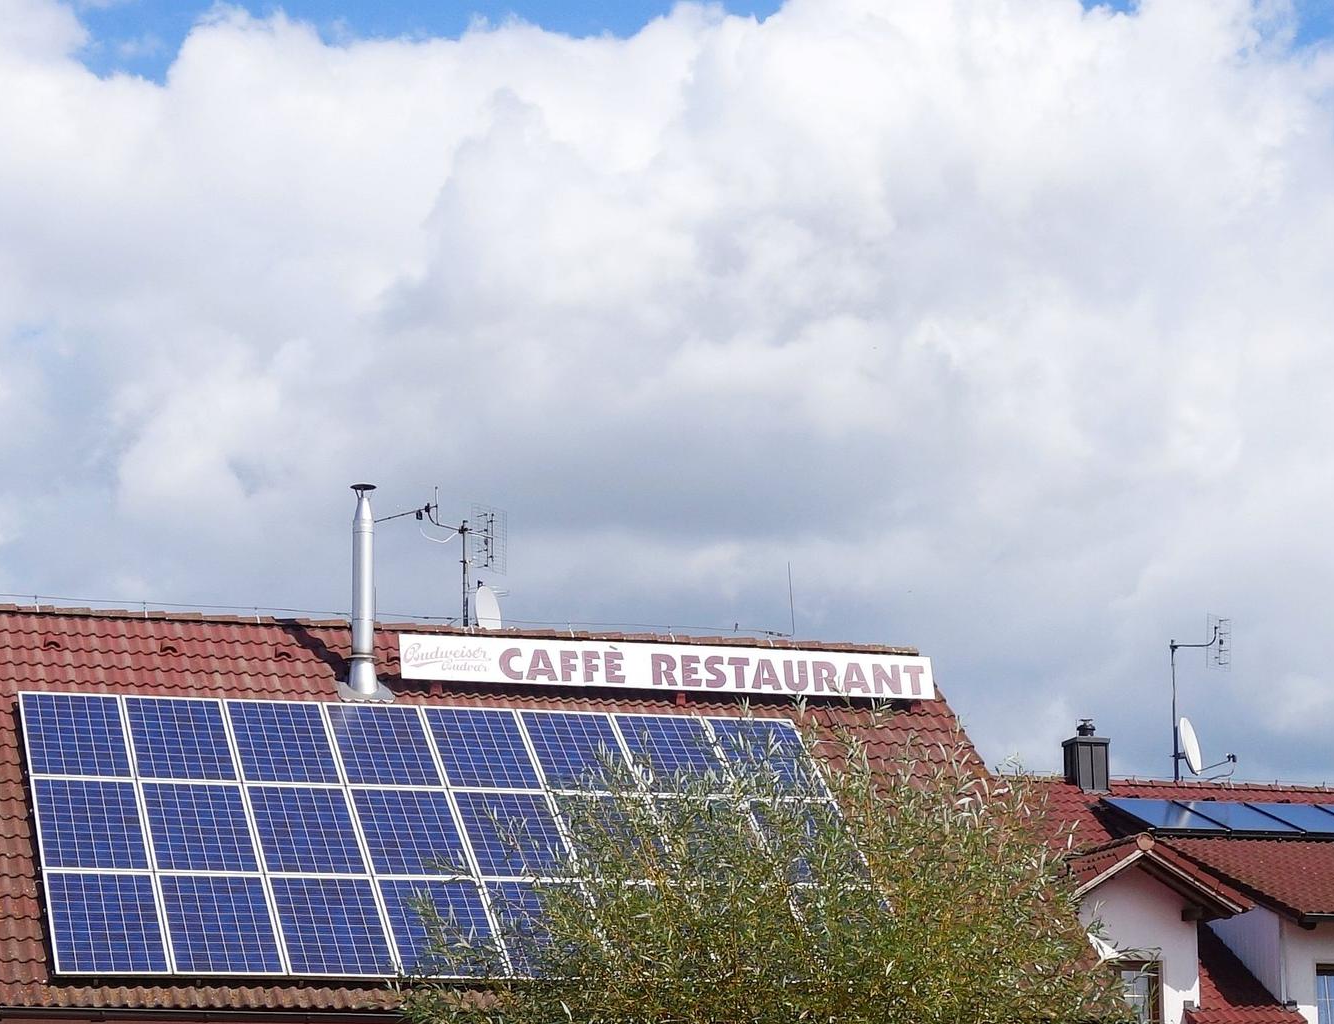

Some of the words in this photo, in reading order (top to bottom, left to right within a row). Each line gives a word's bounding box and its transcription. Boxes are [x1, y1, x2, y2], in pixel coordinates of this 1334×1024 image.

[403, 643, 491, 666] Budweiser
[441, 660, 490, 672] Budvar
[499, 645, 626, 683] CAFFÈ
[651, 653, 925, 695] RESTAURANT
